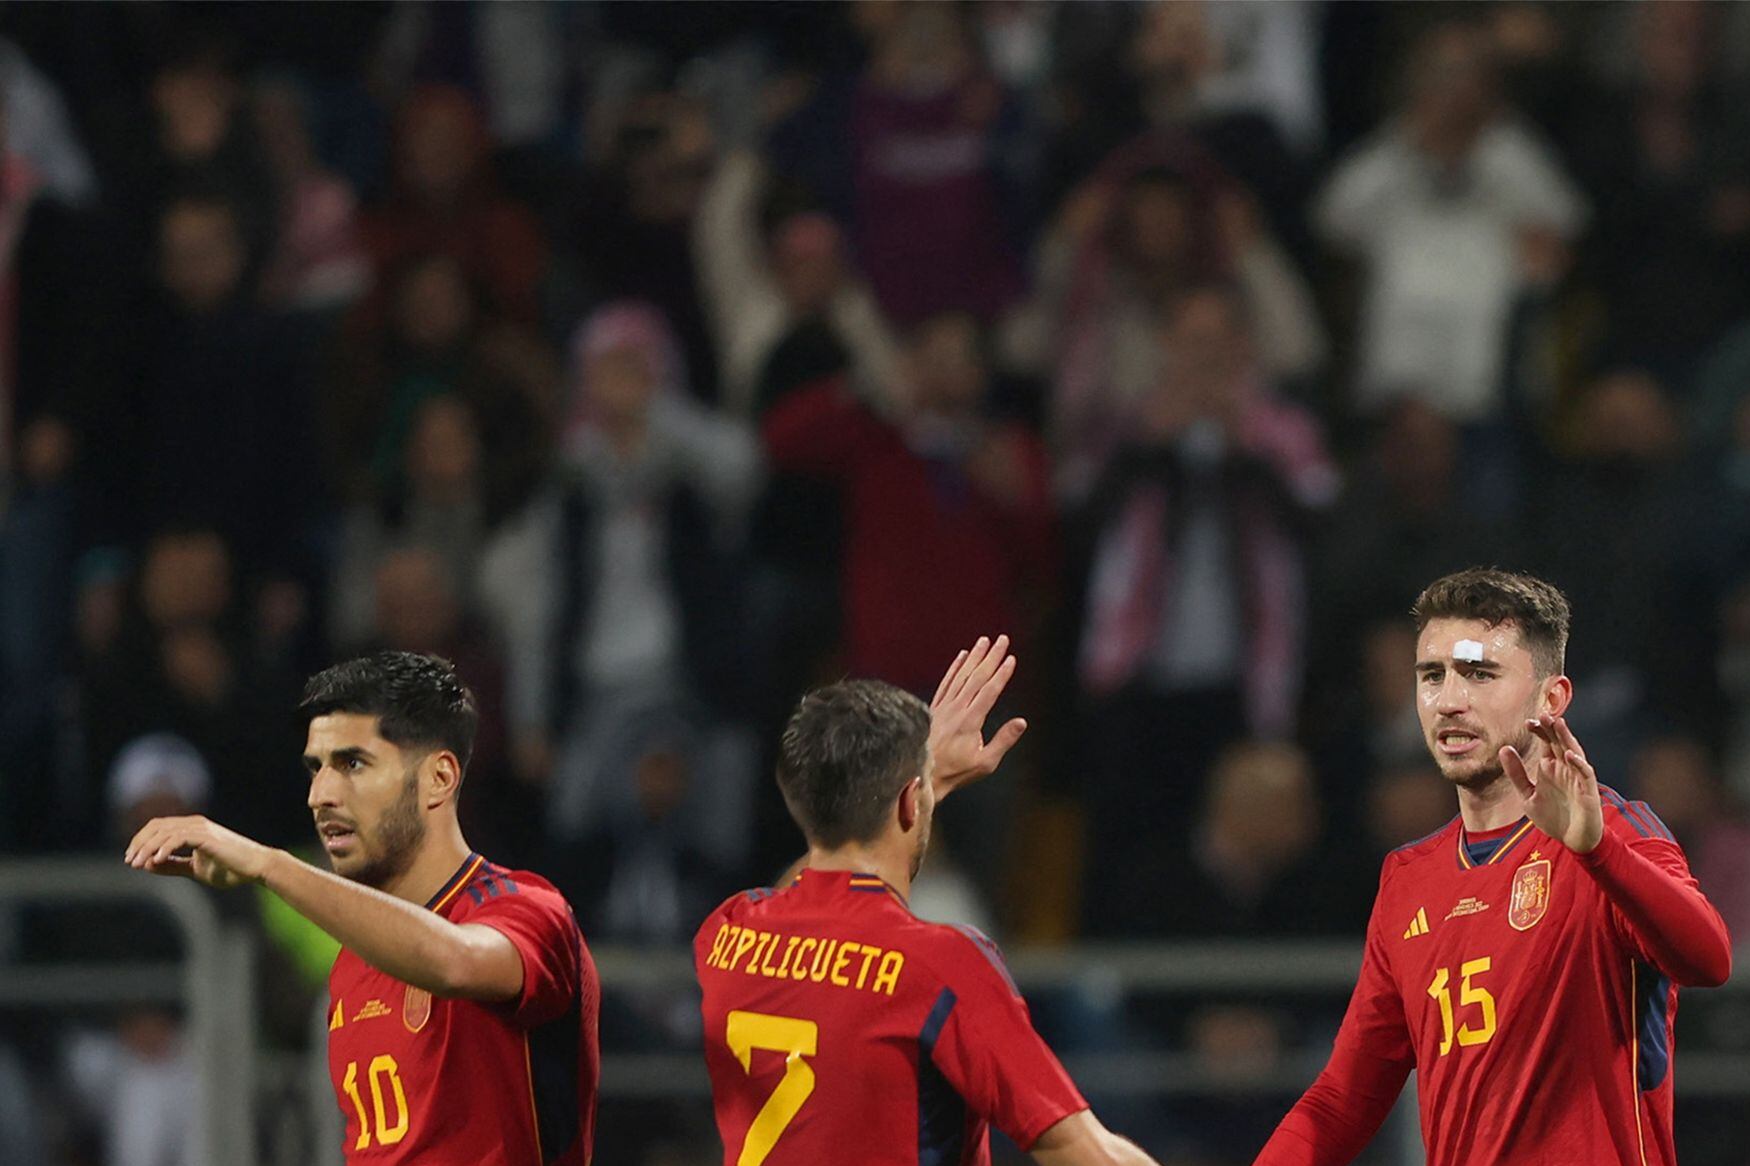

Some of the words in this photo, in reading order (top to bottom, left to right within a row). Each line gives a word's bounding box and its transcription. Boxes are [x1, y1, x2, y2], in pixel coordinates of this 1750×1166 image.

[707, 924, 905, 996] AZPILICUETA
[1427, 957, 1497, 1056] 15
[343, 1055, 409, 1150] 10
